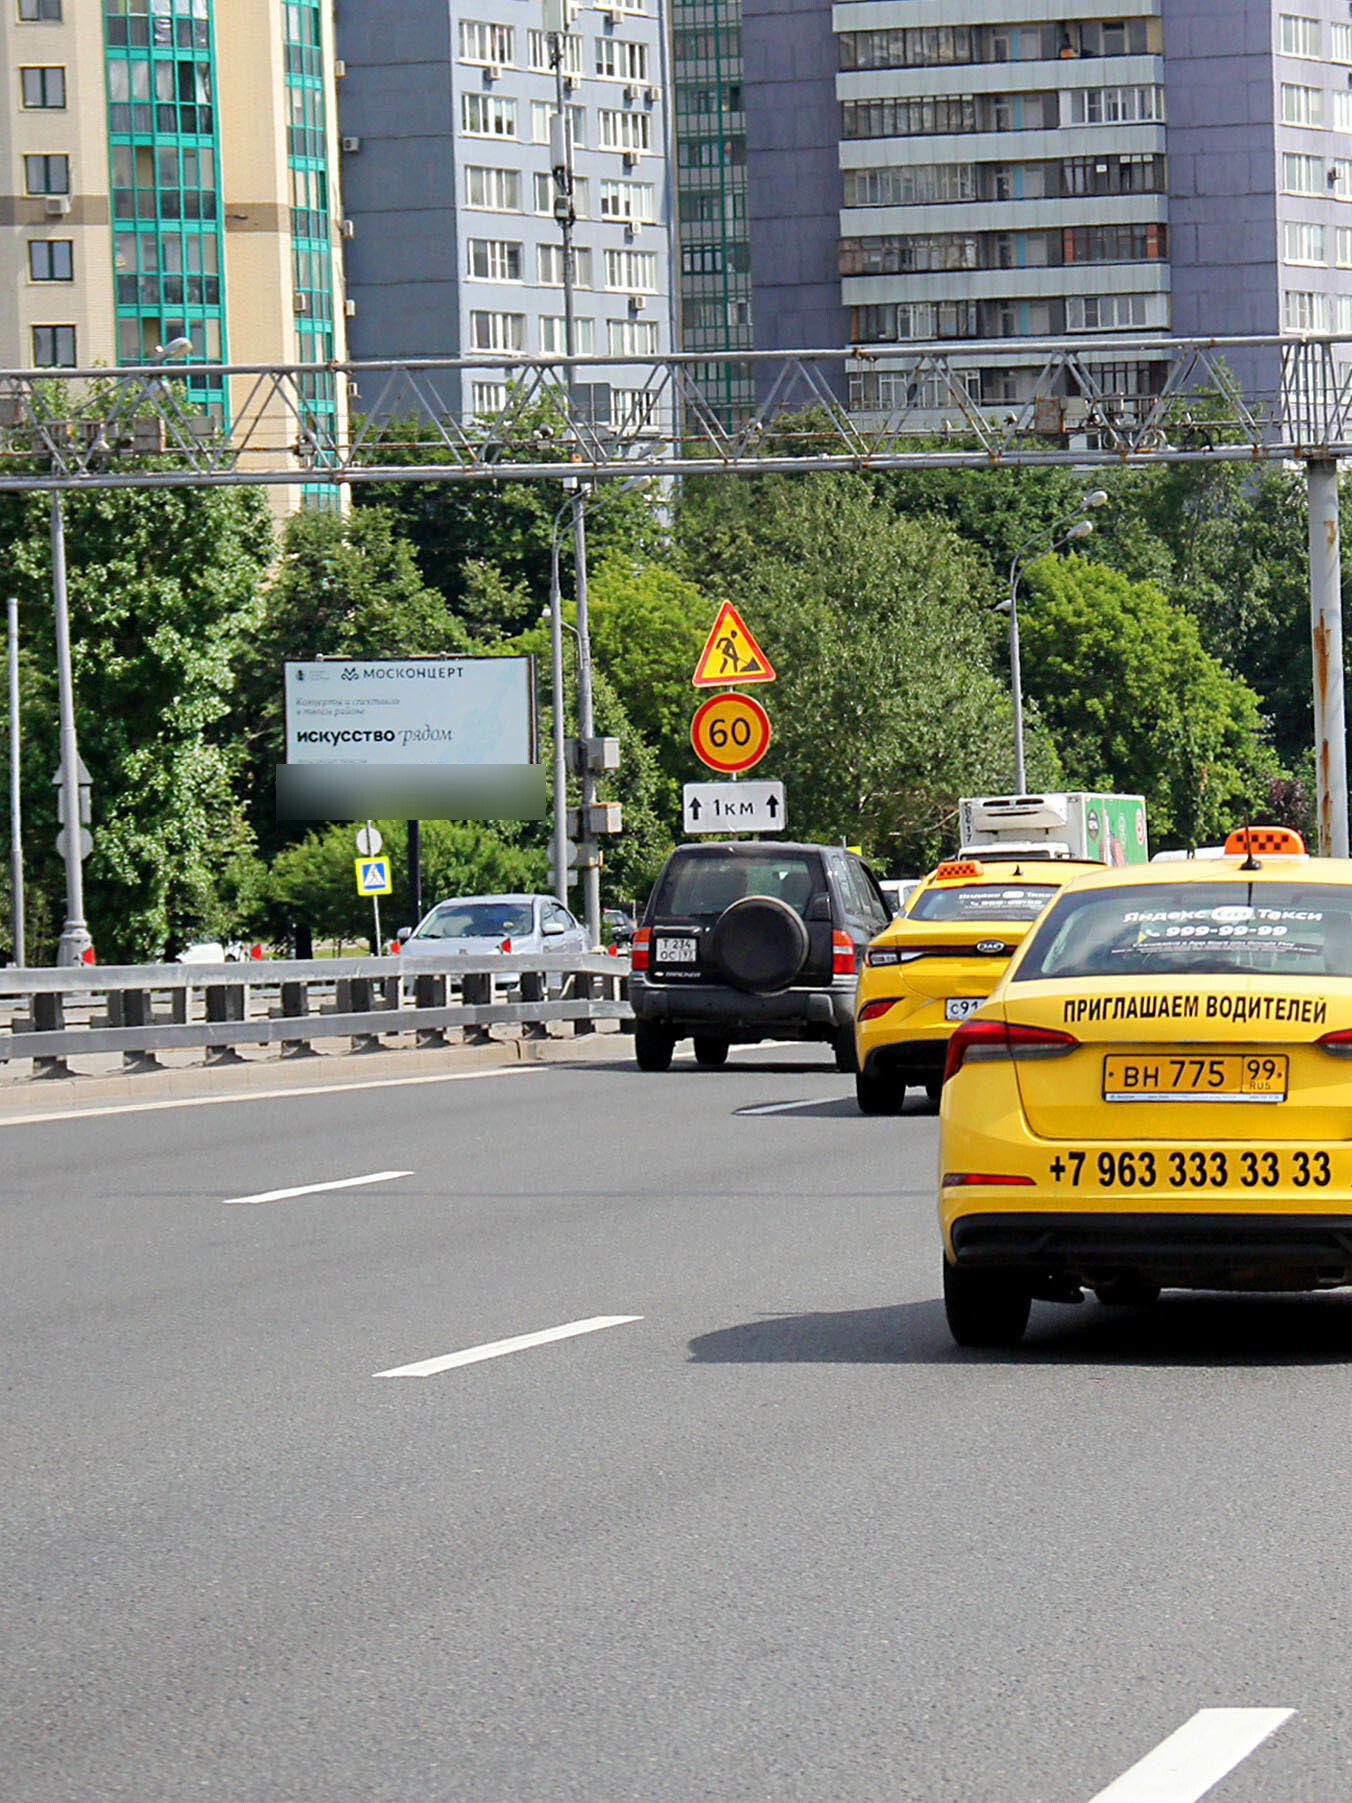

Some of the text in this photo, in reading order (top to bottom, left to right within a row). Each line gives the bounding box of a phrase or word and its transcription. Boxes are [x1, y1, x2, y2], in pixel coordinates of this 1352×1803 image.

[363, 667, 464, 680] МОСКОНЦЕРТ
[297, 724, 453, 746] искусство рядом
[709, 717, 751, 748] 60
[1123, 911, 1207, 922] Яндекс
[1257, 909, 1323, 921] Такси
[1166, 925, 1289, 937] 999-99-99
[1064, 996, 1327, 1024] ПРИГЛАШАЕМ ВОДИТЕЛЕЙ
[1123, 1059, 1276, 1087] ВН 775 99
[1249, 1081, 1271, 1090] RUS
[1050, 1151, 1332, 1187] +7 963 333 33 33
